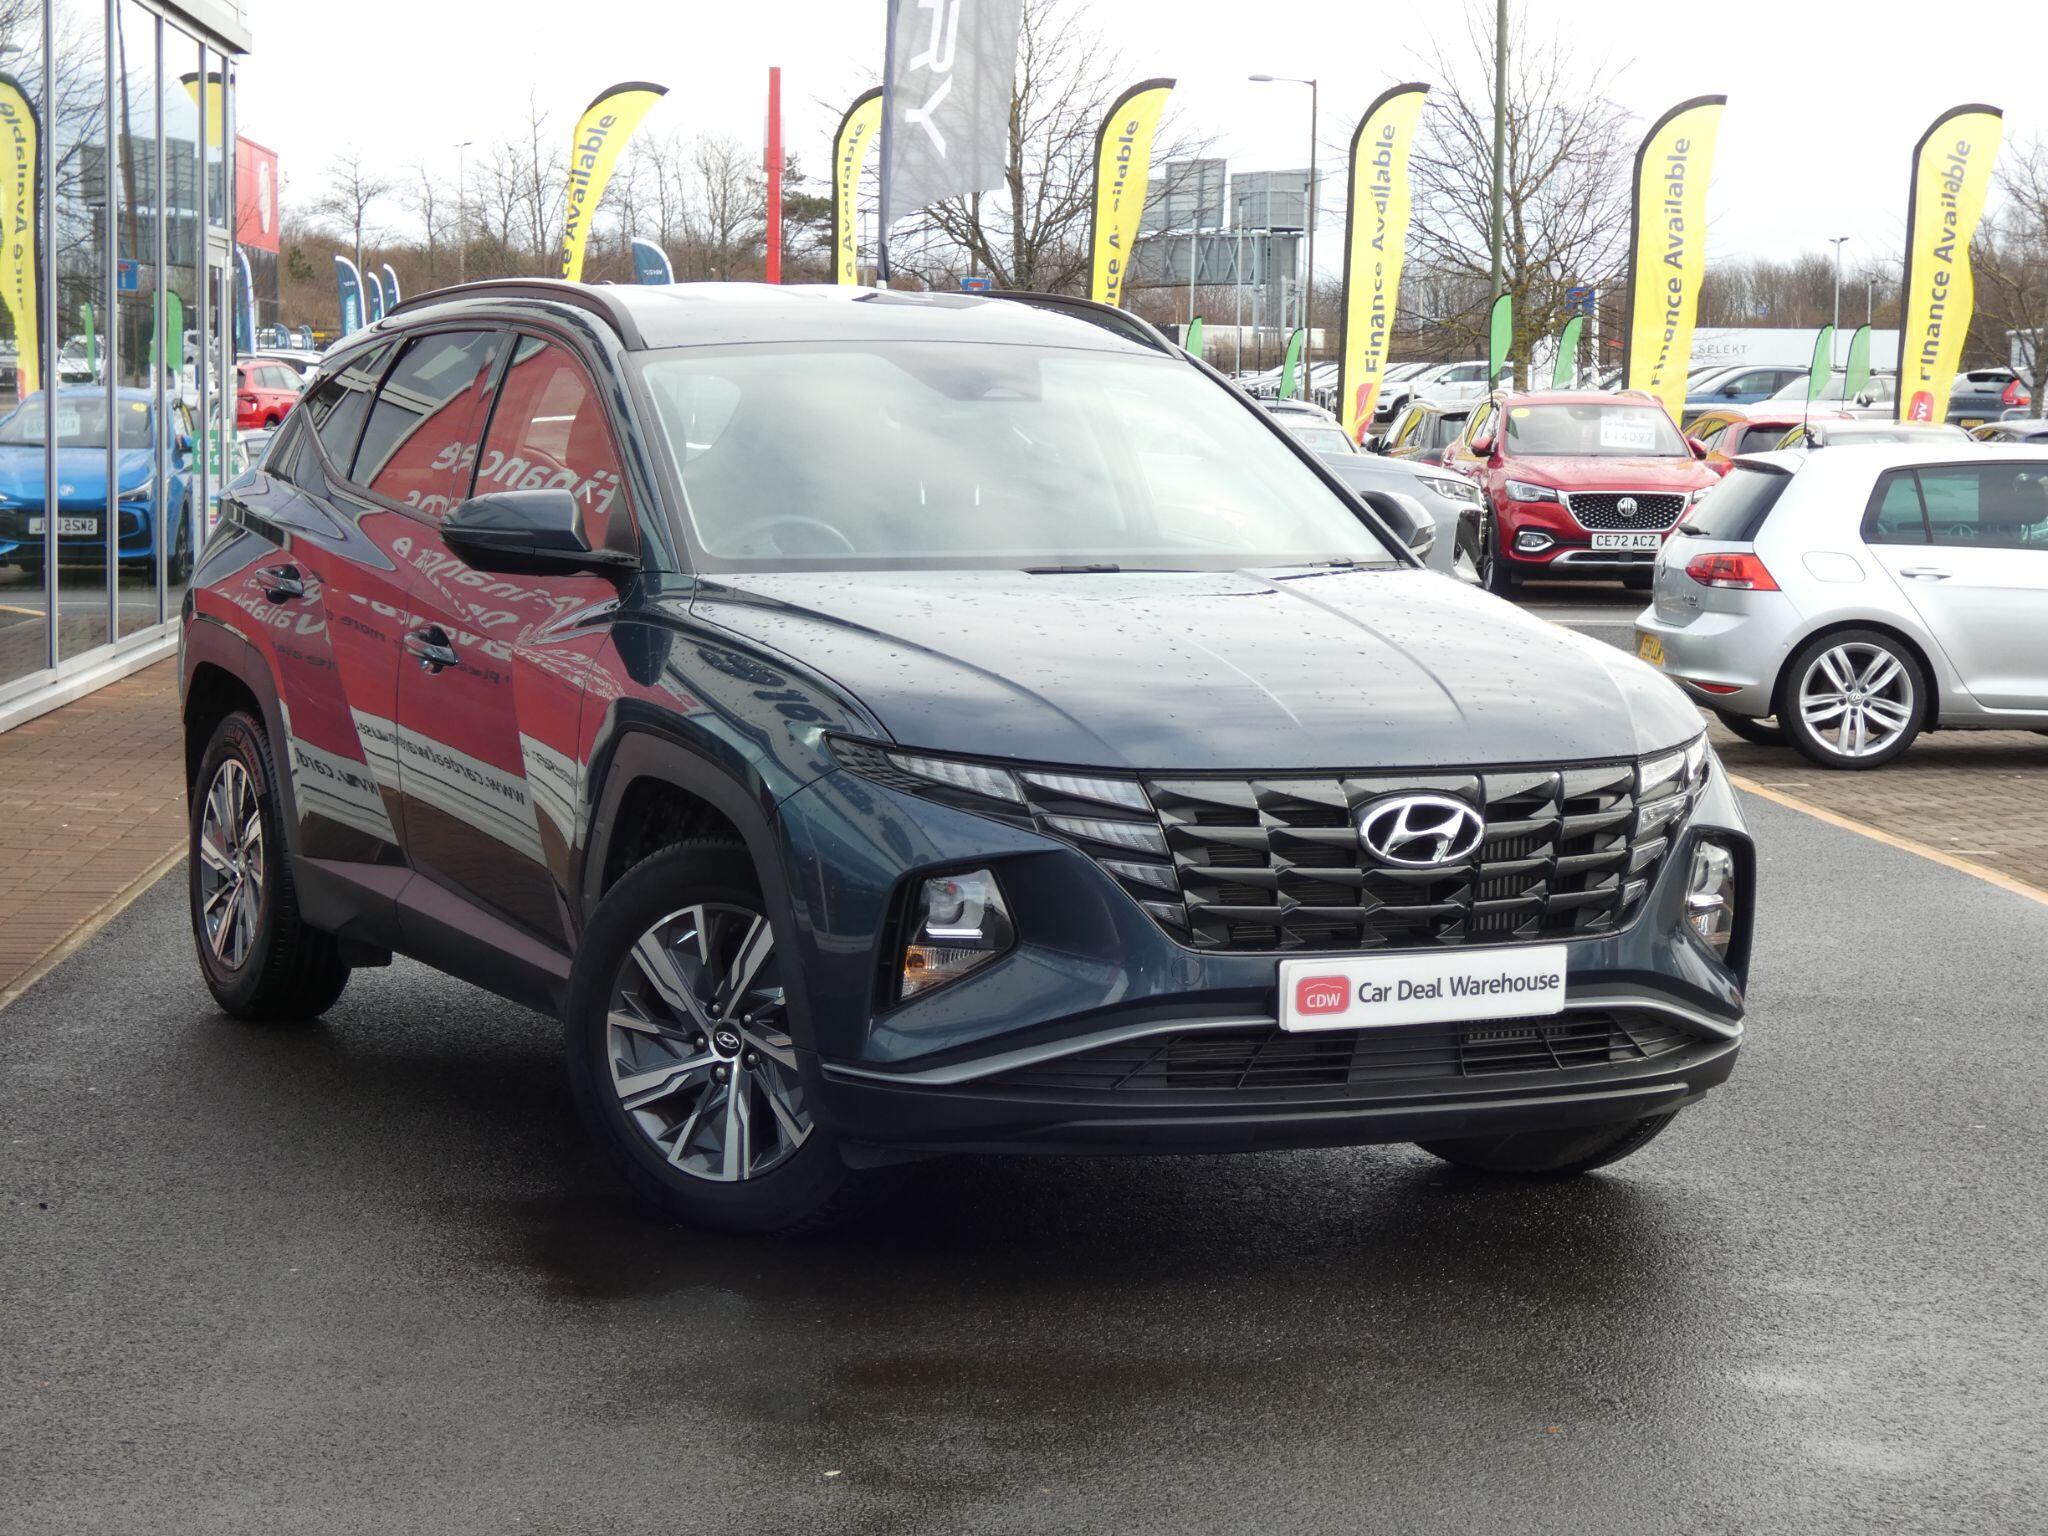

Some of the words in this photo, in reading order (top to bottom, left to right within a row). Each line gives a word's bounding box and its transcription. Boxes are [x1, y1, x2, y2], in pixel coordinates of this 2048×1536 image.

[564, 114, 617, 241] Available
[1108, 120, 1139, 250] Ailable
[1369, 124, 1396, 252] Available
[1663, 138, 1691, 269] Available
[1932, 140, 1972, 264] Available
[1364, 262, 1386, 373] Finance
[1651, 277, 1683, 385] Finance
[1698, 344, 1748, 354] SELEKT
[1920, 270, 1950, 381] Finance
[1596, 535, 1628, 546] CE72
[1632, 535, 1656, 546] ACZ
[1306, 992, 1341, 1008] CDW
[1358, 982, 1391, 1003] Car
[1398, 975, 1443, 1001] Deal
[1449, 973, 1560, 998] Warehouse
